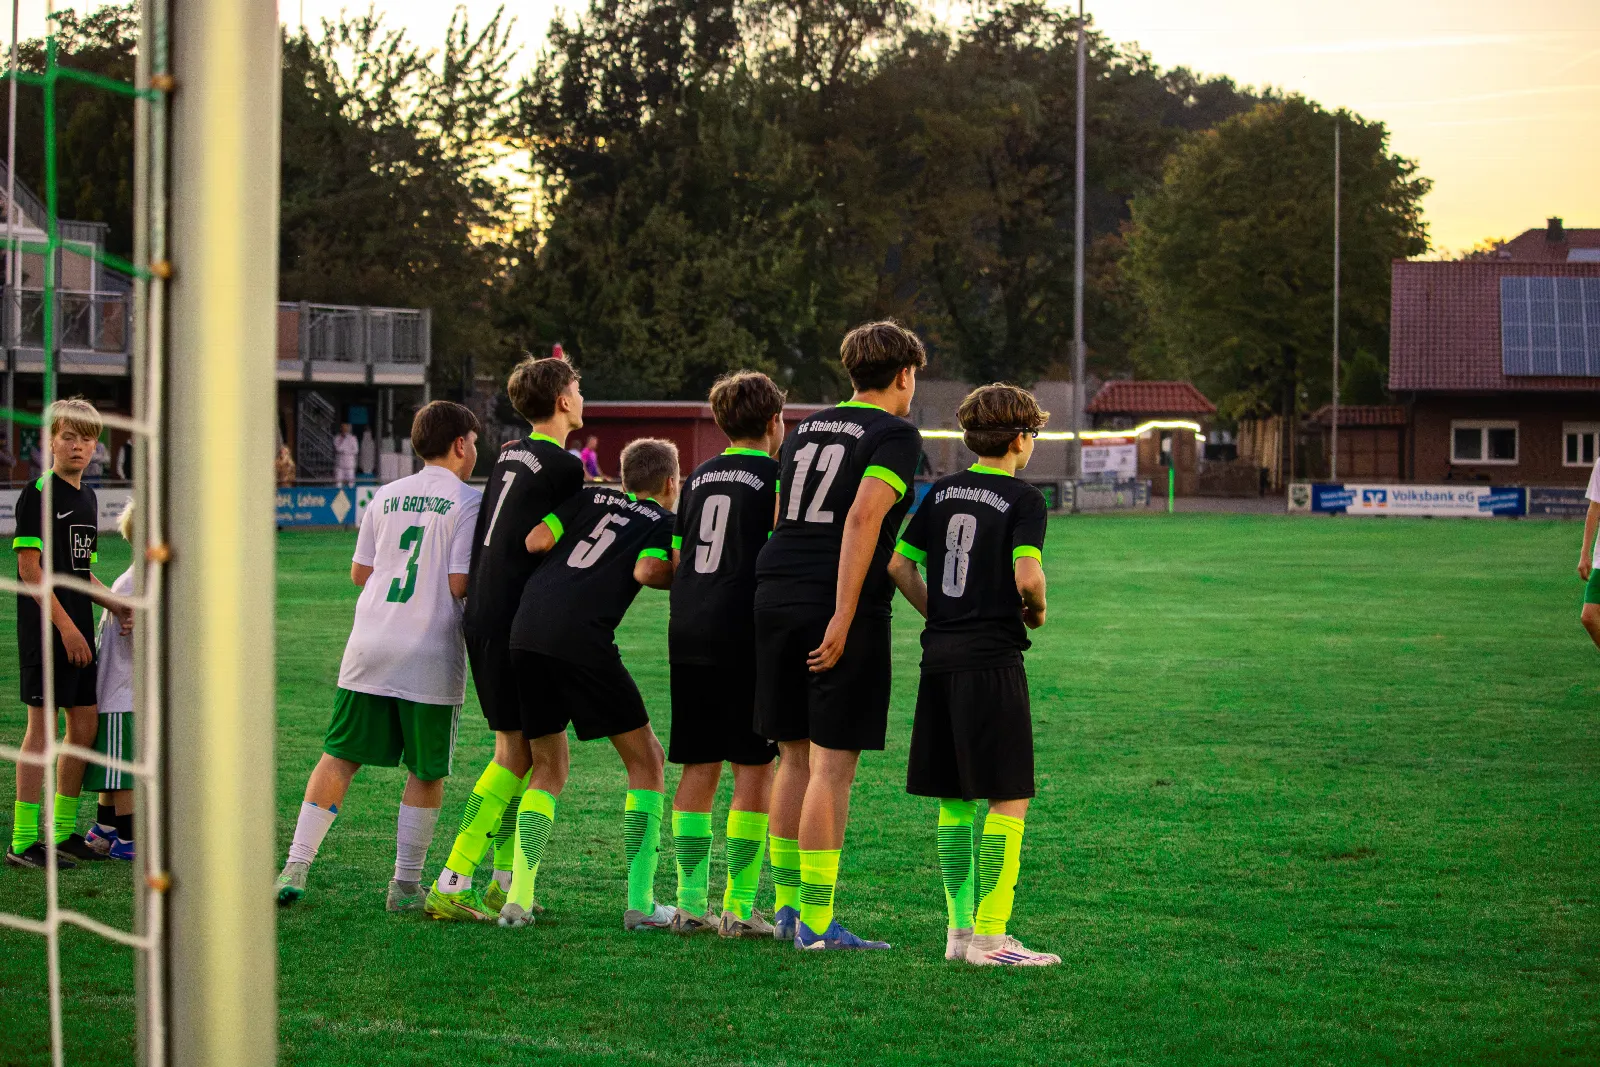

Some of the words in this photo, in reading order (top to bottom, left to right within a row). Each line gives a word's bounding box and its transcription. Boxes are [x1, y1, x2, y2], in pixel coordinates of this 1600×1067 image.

[797, 422, 809, 435] SG
[383, 496, 401, 515] GW
[484, 470, 516, 547] 1
[691, 476, 701, 491] SG
[786, 442, 845, 523] 12
[935, 489, 945, 504] SG
[945, 486, 1010, 513] Steinfeld/Mühlen
[1391, 489, 1454, 501] Volksbank
[567, 512, 630, 569] 5
[694, 494, 731, 574] 9
[942, 513, 977, 598] 8
[386, 526, 425, 604] 3
